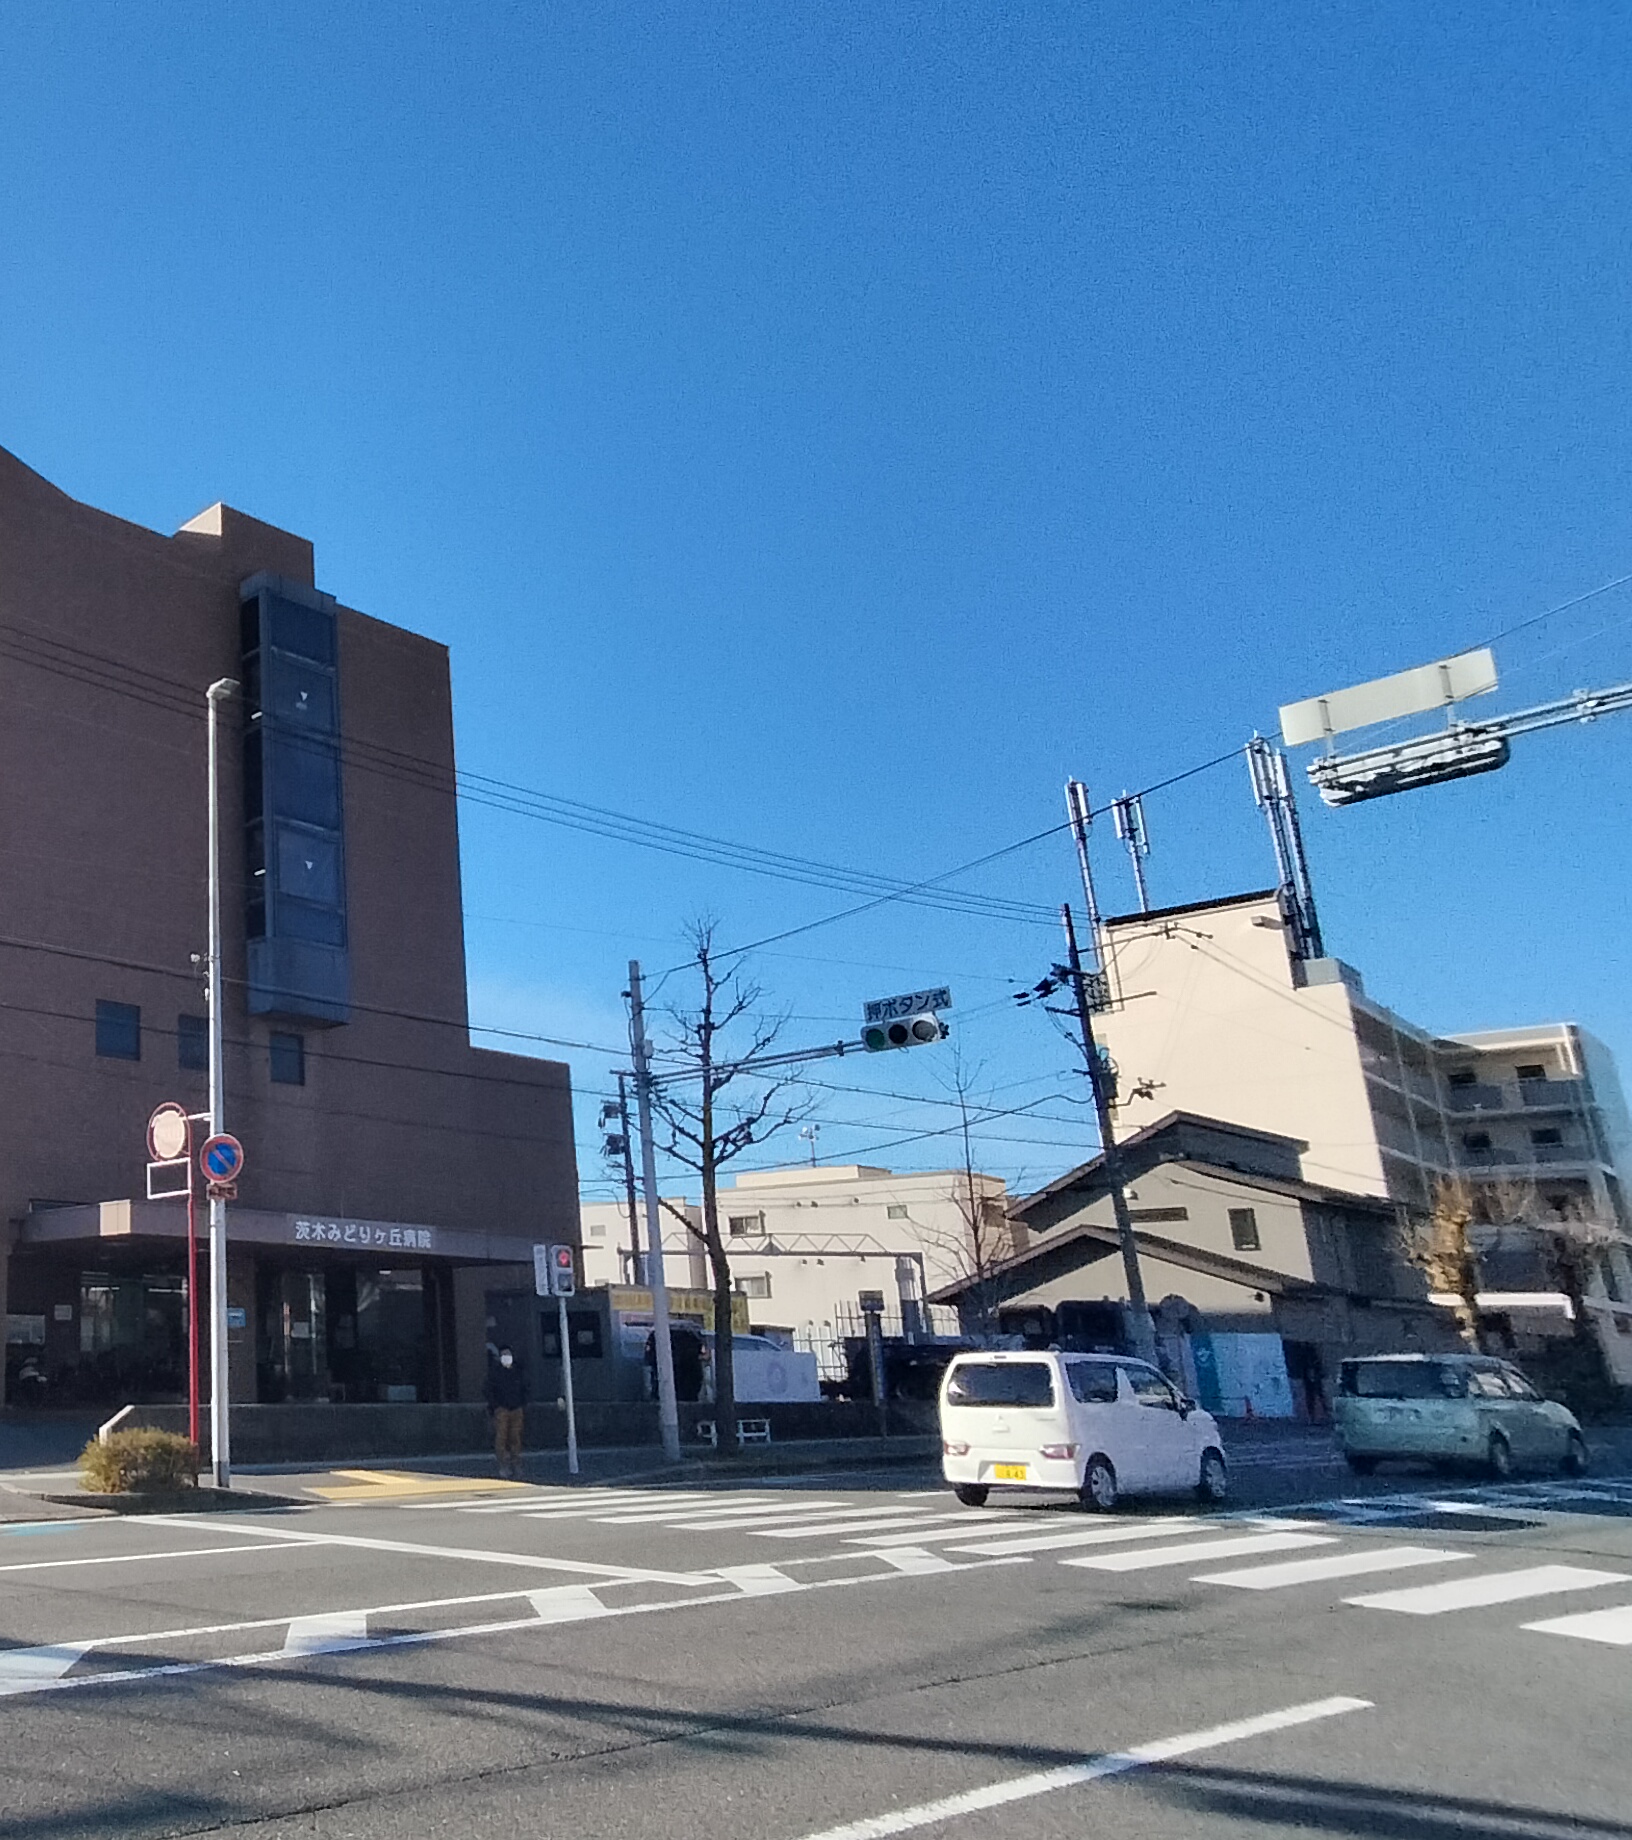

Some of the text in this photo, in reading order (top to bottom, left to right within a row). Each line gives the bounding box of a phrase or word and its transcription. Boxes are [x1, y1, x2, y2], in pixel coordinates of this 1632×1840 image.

[867, 988, 949, 1020] 押ボタン式
